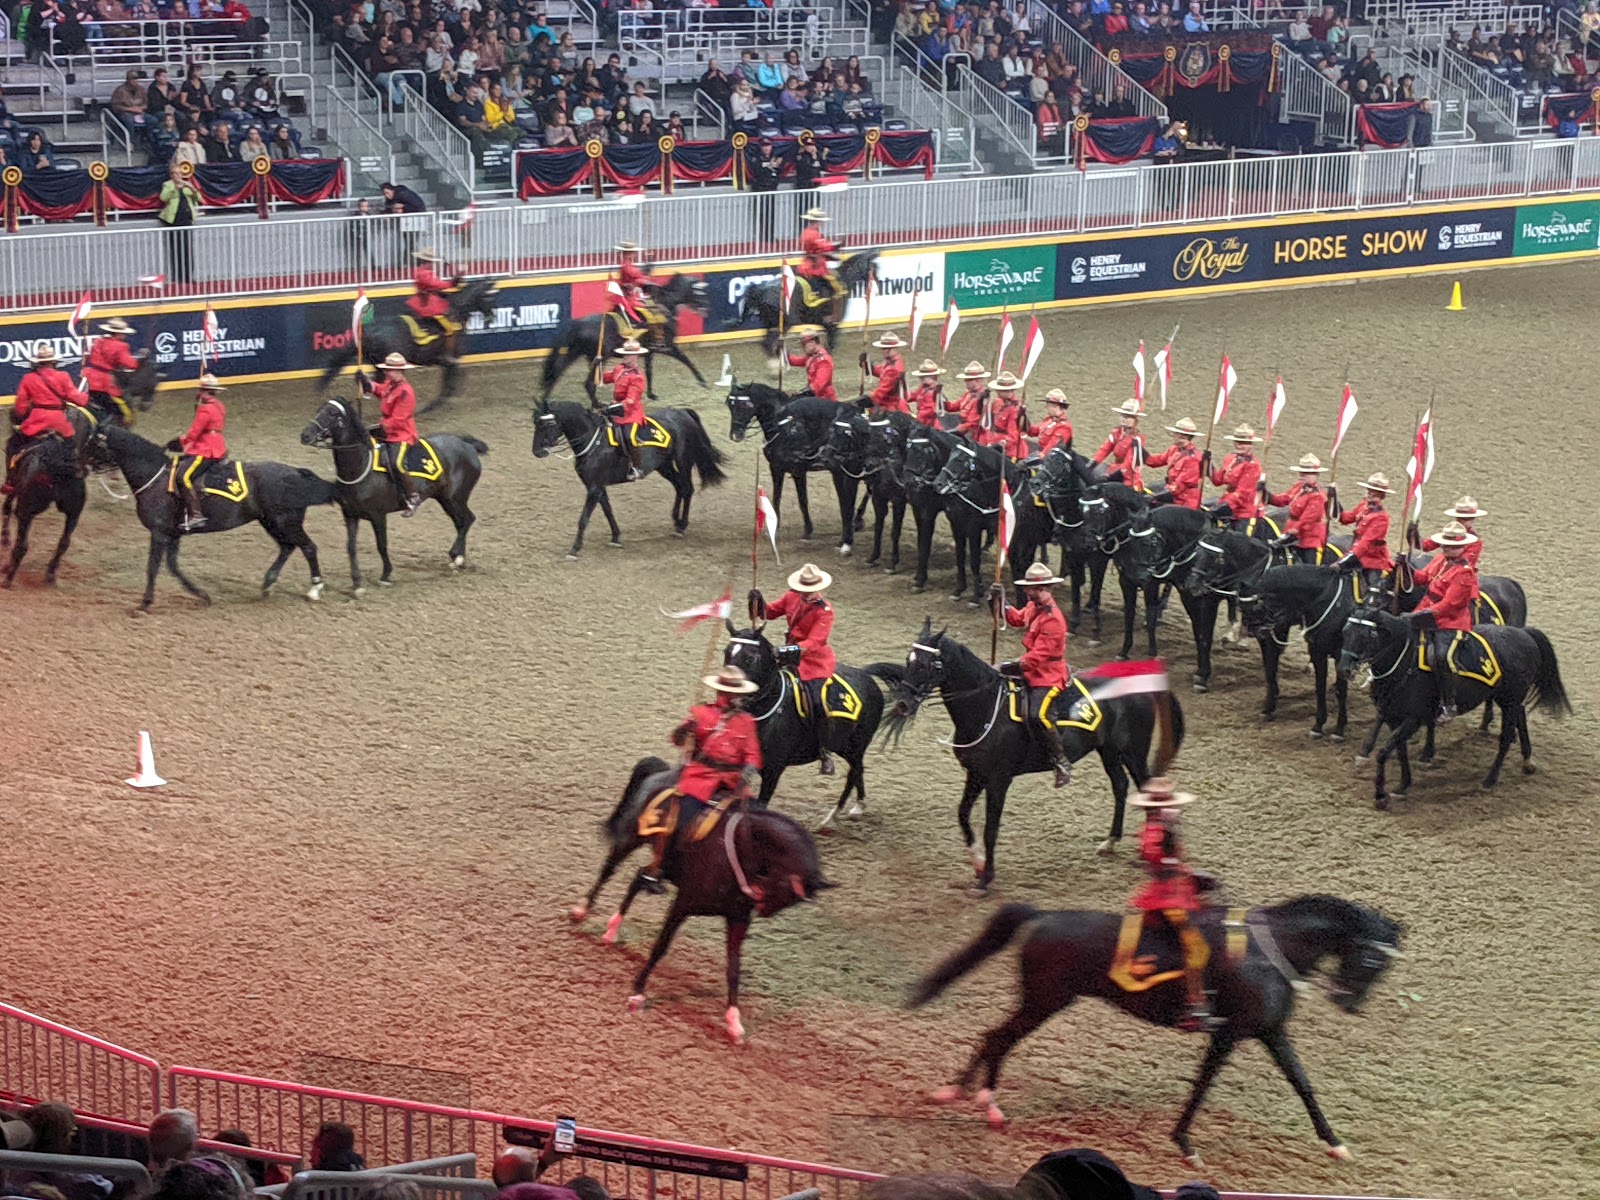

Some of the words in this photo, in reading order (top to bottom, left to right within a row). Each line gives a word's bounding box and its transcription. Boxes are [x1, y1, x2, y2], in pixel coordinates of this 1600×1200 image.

[1454, 223, 1482, 235] HENRY
[1522, 219, 1592, 239] HORSEWARE
[1274, 235, 1348, 264] HORSE
[1361, 228, 1428, 256] SHOW
[1454, 231, 1502, 245] EQUESTRIAN
[1090, 254, 1122, 265] HENRY
[1173, 237, 1250, 281] Royal
[954, 266, 1045, 289] HORSEWARE
[1090, 262, 1146, 277] EQUESTRIAN
[182, 328, 228, 342] HERY
[183, 338, 265, 355] EQUESTRIAN
